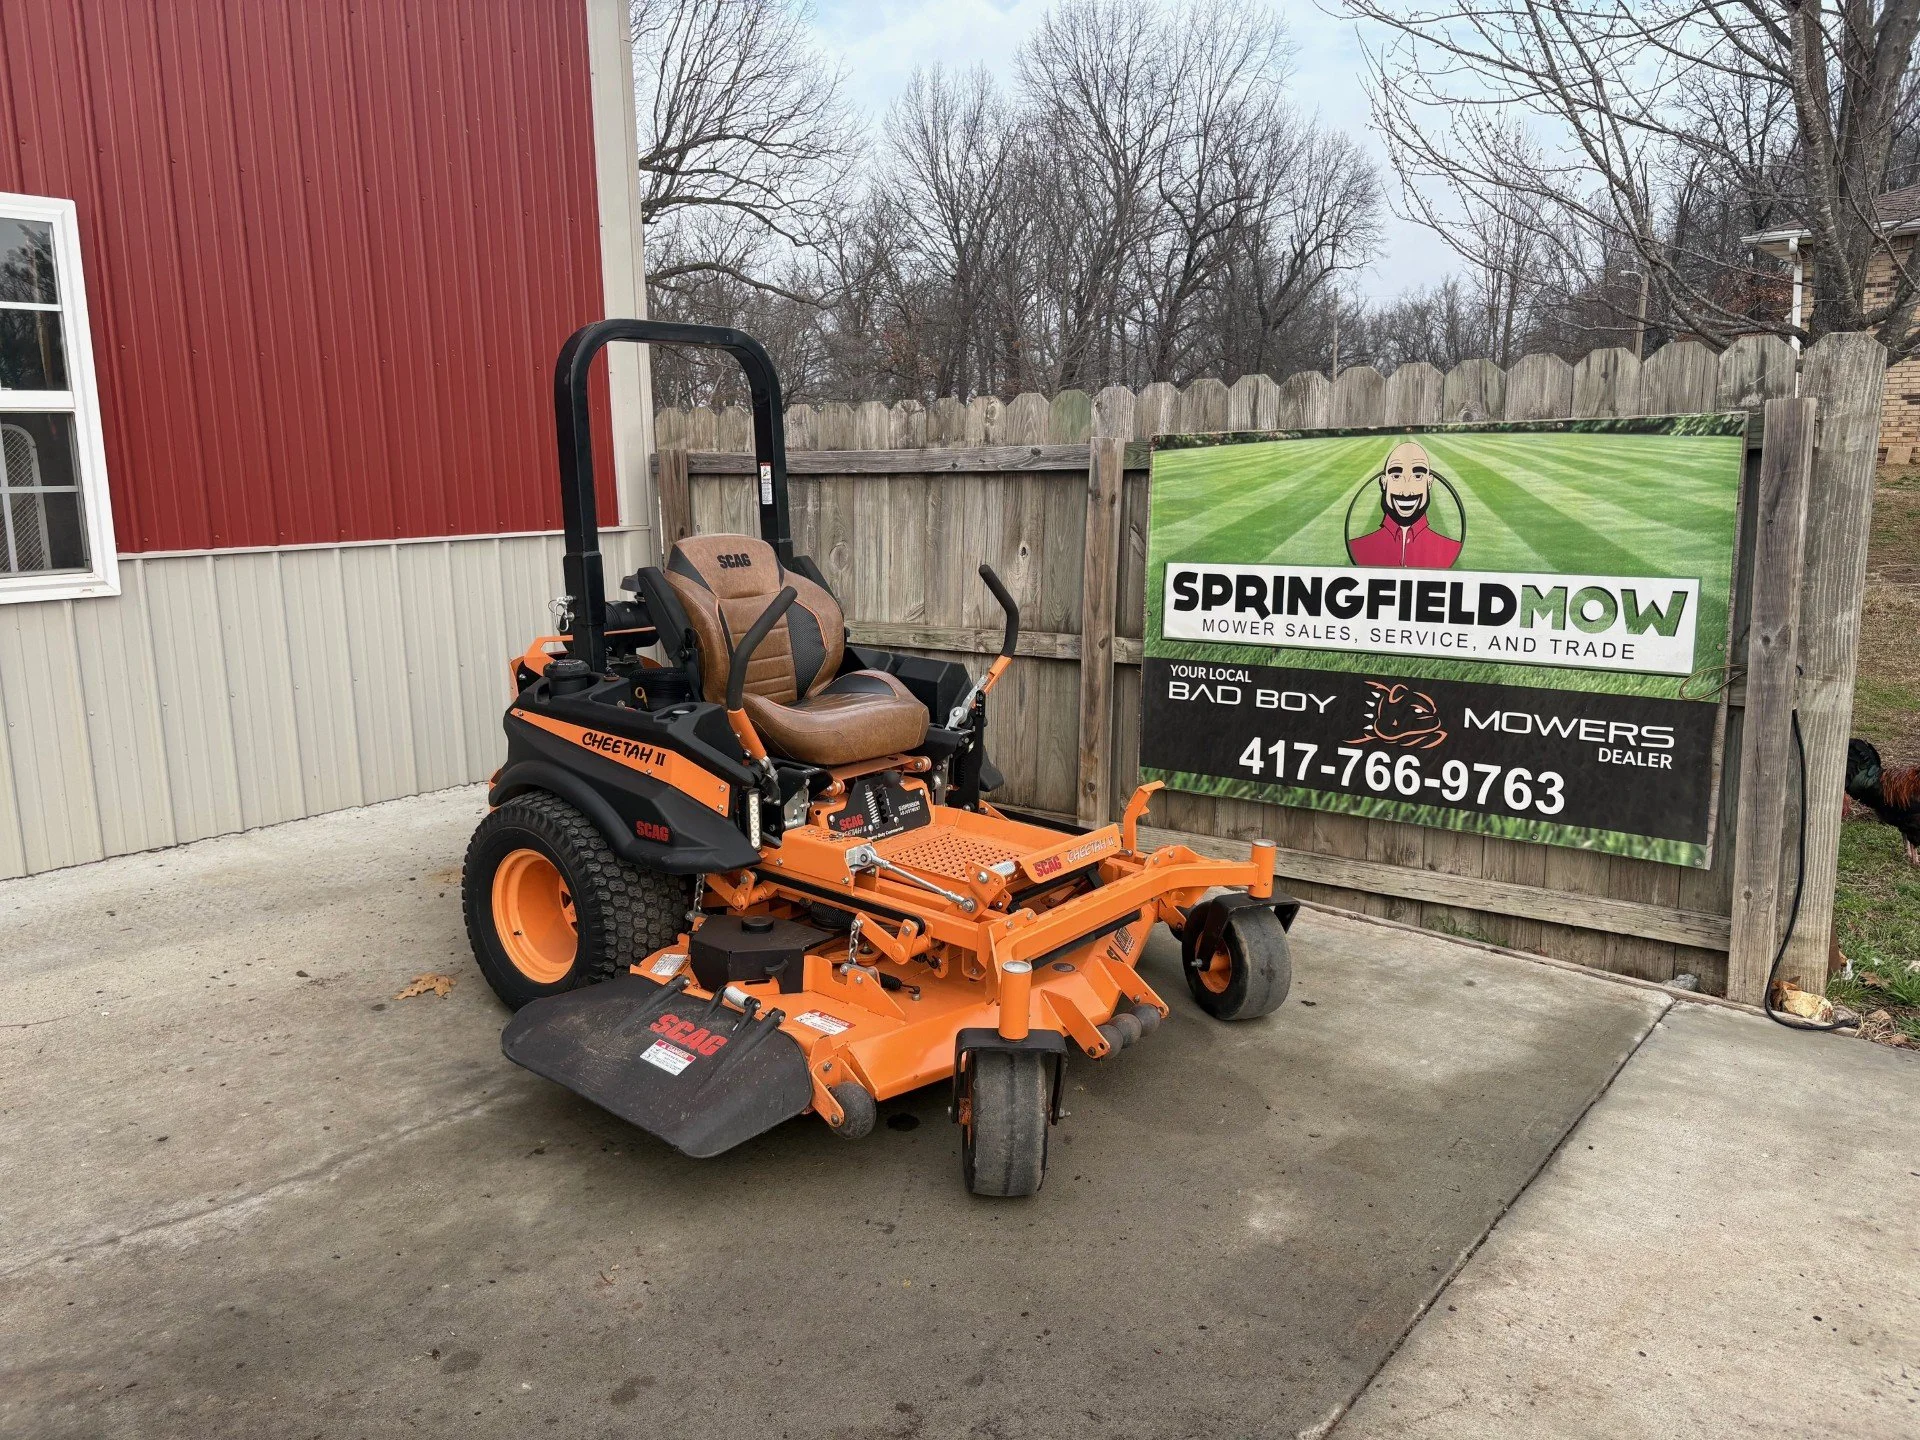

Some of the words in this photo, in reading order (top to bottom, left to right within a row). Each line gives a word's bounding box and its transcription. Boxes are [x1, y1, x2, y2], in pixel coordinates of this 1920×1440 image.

[717, 553, 751, 569] SCAG
[1202, 618, 1275, 636] MOWER
[1285, 623, 1358, 643] SALES,
[1370, 628, 1477, 651] SERVICE,
[1488, 635, 1537, 653] AND
[1550, 639, 1635, 660] TRADE
[1170, 664, 1207, 680] YOUR
[1209, 667, 1252, 683] LOCAL
[1168, 681, 1242, 705] BAD
[1255, 689, 1337, 714] BOY
[1463, 707, 1675, 749] MOWERS
[582, 732, 653, 763] CHEETAH
[655, 752, 666, 766] II
[1598, 747, 1673, 770] DEALER
[1239, 737, 1565, 815] 417-766-9763
[636, 820, 669, 842] SCAG
[840, 813, 864, 831] SCAG
[1033, 855, 1062, 878] SCAG
[1067, 837, 1107, 863] CHEETAH
[649, 1014, 729, 1056] SCAG
